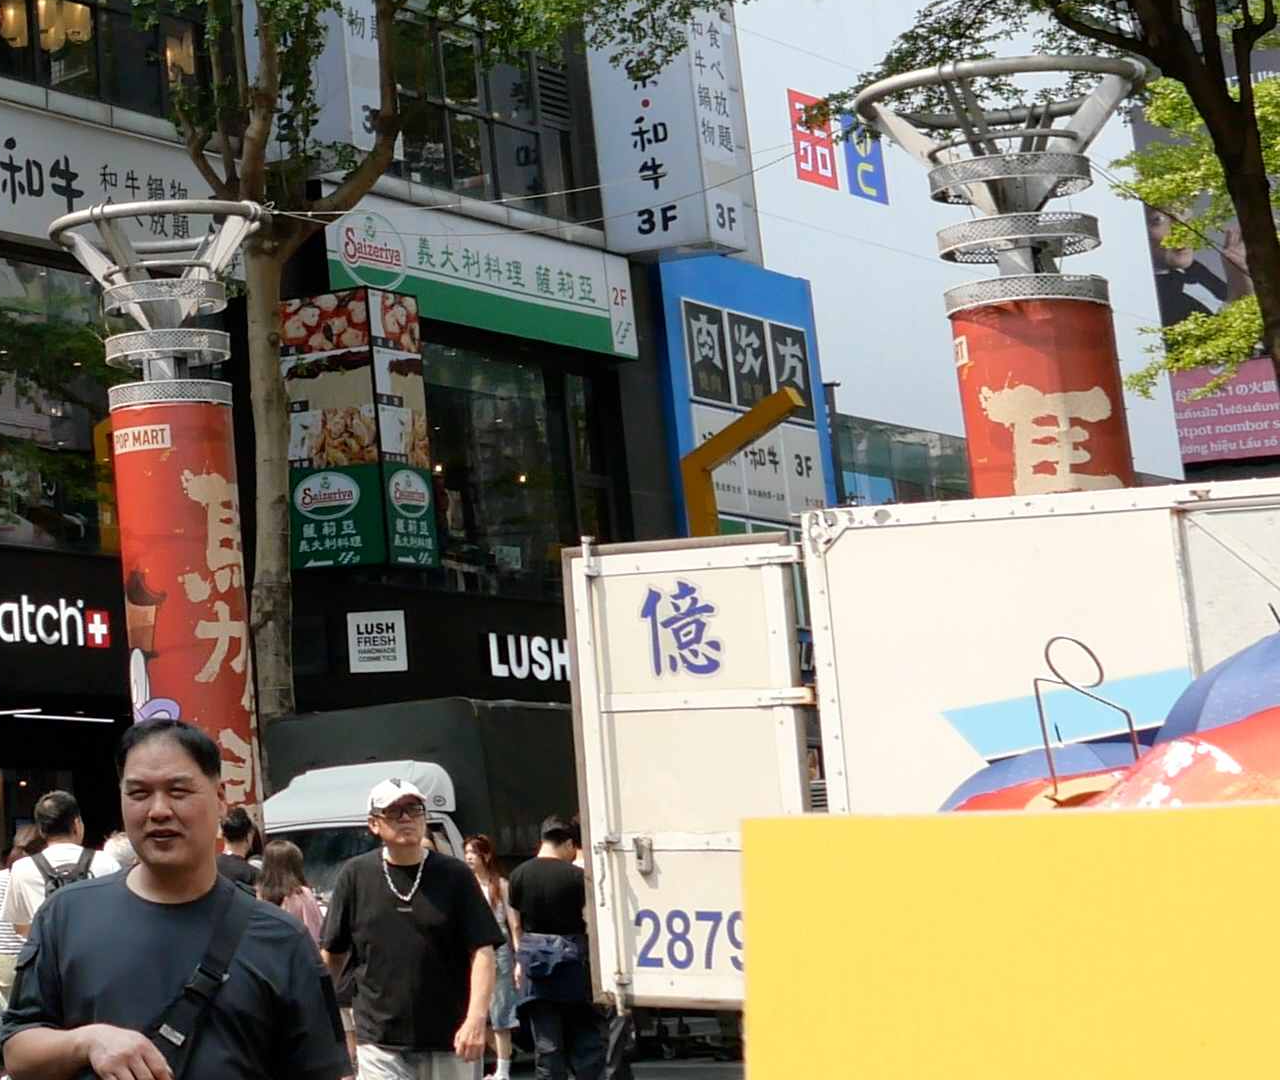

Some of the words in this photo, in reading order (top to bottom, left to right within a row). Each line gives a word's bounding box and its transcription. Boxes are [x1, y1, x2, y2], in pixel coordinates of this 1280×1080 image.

[637, 204, 678, 236] 3F
[715, 203, 737, 232] 3F
[343, 226, 402, 270] Saizeriya
[416, 236, 527, 288] 義大利料理
[536, 261, 597, 304] 薩莉亞
[611, 286, 628, 308] 2F
[132, 428, 167, 447] MART
[794, 453, 813, 478] 3F
[356, 621, 396, 636] LUSH
[357, 635, 396, 647] FRESH
[640, 580, 724, 678] 億
